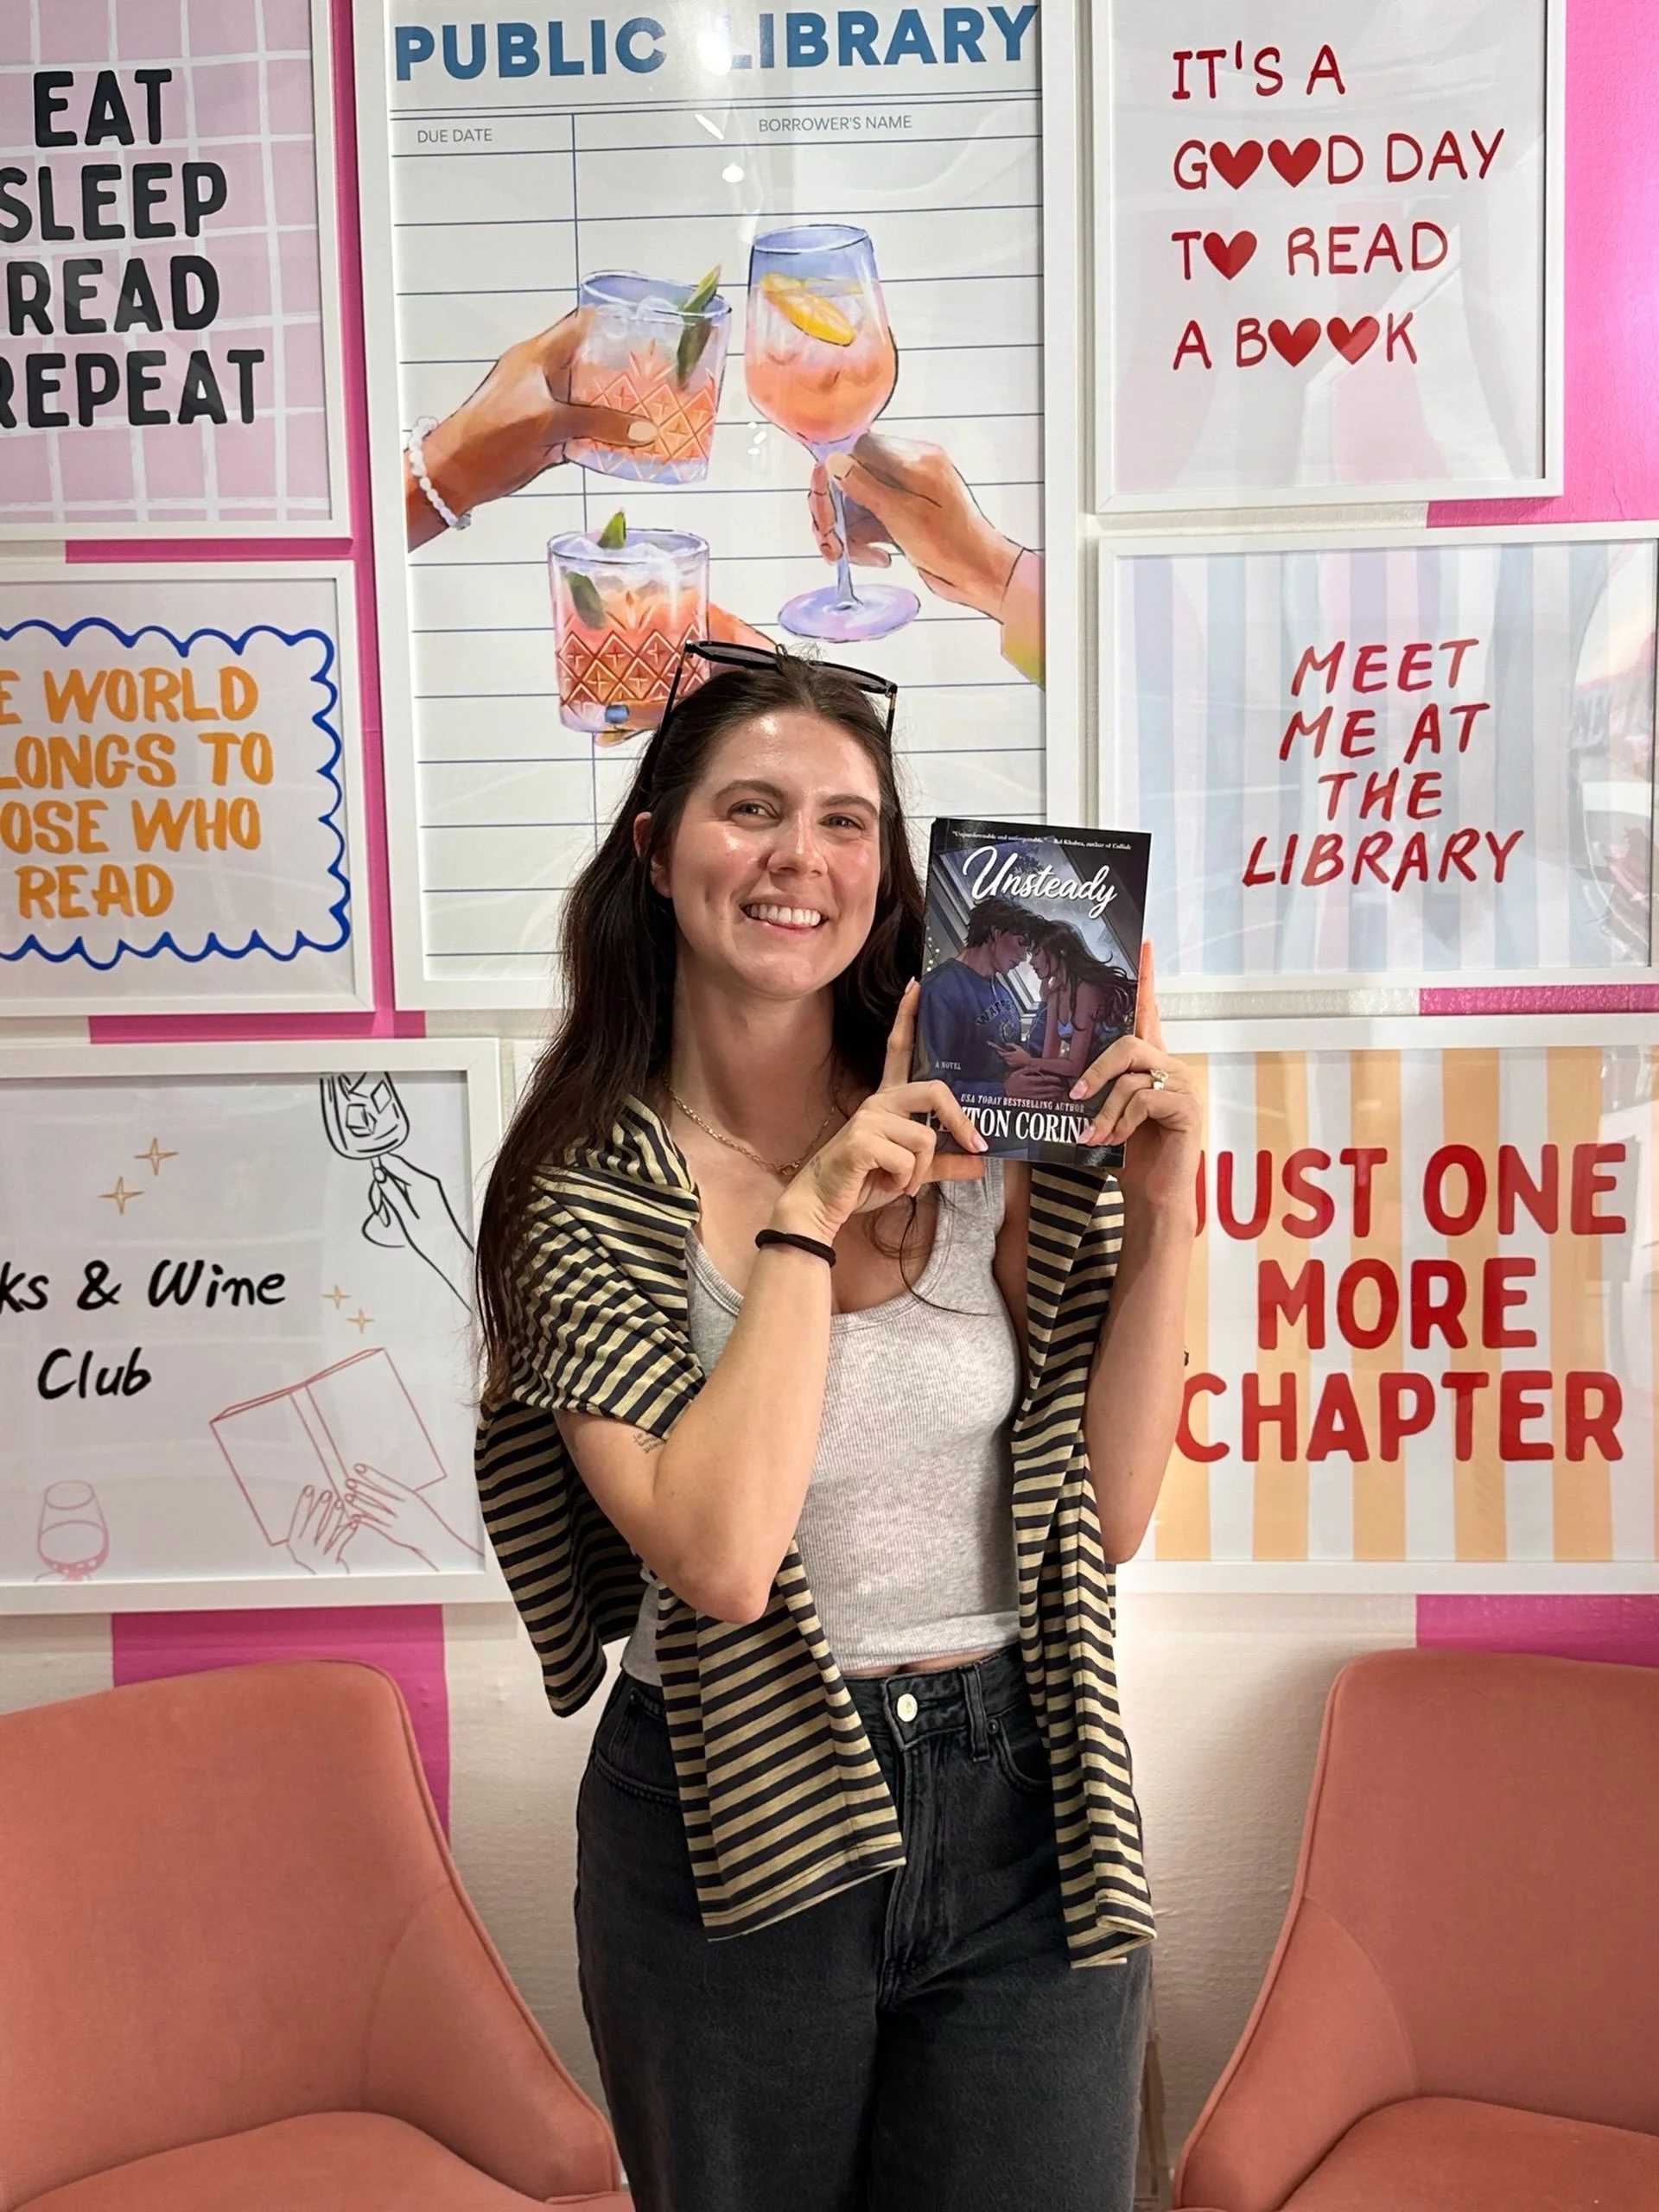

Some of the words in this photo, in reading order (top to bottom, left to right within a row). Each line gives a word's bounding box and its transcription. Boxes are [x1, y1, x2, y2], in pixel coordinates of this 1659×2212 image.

[395, 17, 666, 81] PUBLIC
[1172, 40, 1284, 100] IT'S
[1306, 44, 1346, 95] A
[32, 68, 173, 149] EAT
[416, 129, 448, 144] DUE
[452, 127, 493, 143] DATE
[758, 117, 862, 133] BORROWER'S
[865, 115, 912, 130] NAME
[1385, 128, 1505, 183] DAY
[0, 162, 228, 244] SLEEP
[1287, 221, 1449, 276] READ
[6, 255, 219, 336] READ
[1173, 319, 1212, 371] A
[42, 665, 259, 724] WORLD
[1290, 638, 1479, 696] MEET
[198, 731, 274, 786] TO
[1279, 705, 1376, 761] ME
[1403, 702, 1491, 766] AT
[1318, 766, 1443, 822] THE
[130, 796, 262, 852] WHO
[963, 846, 1117, 918] Unsteady
[1242, 828, 1525, 893] LIBRARY
[14, 861, 175, 920] READ
[960, 1093, 976, 1103] USA
[977, 1095, 1002, 1105] TODAY
[1002, 1096, 1053, 1110] BESTSELLING
[1054, 1103, 1084, 1113] AUTHOR
[1421, 1142, 1628, 1236] ONE
[76, 1259, 122, 1311] &
[147, 1259, 286, 1308] Wine
[1256, 1255, 1539, 1350] MORE
[37, 1346, 153, 1401] Club
[1175, 1369, 1624, 1464] CHAPTER
